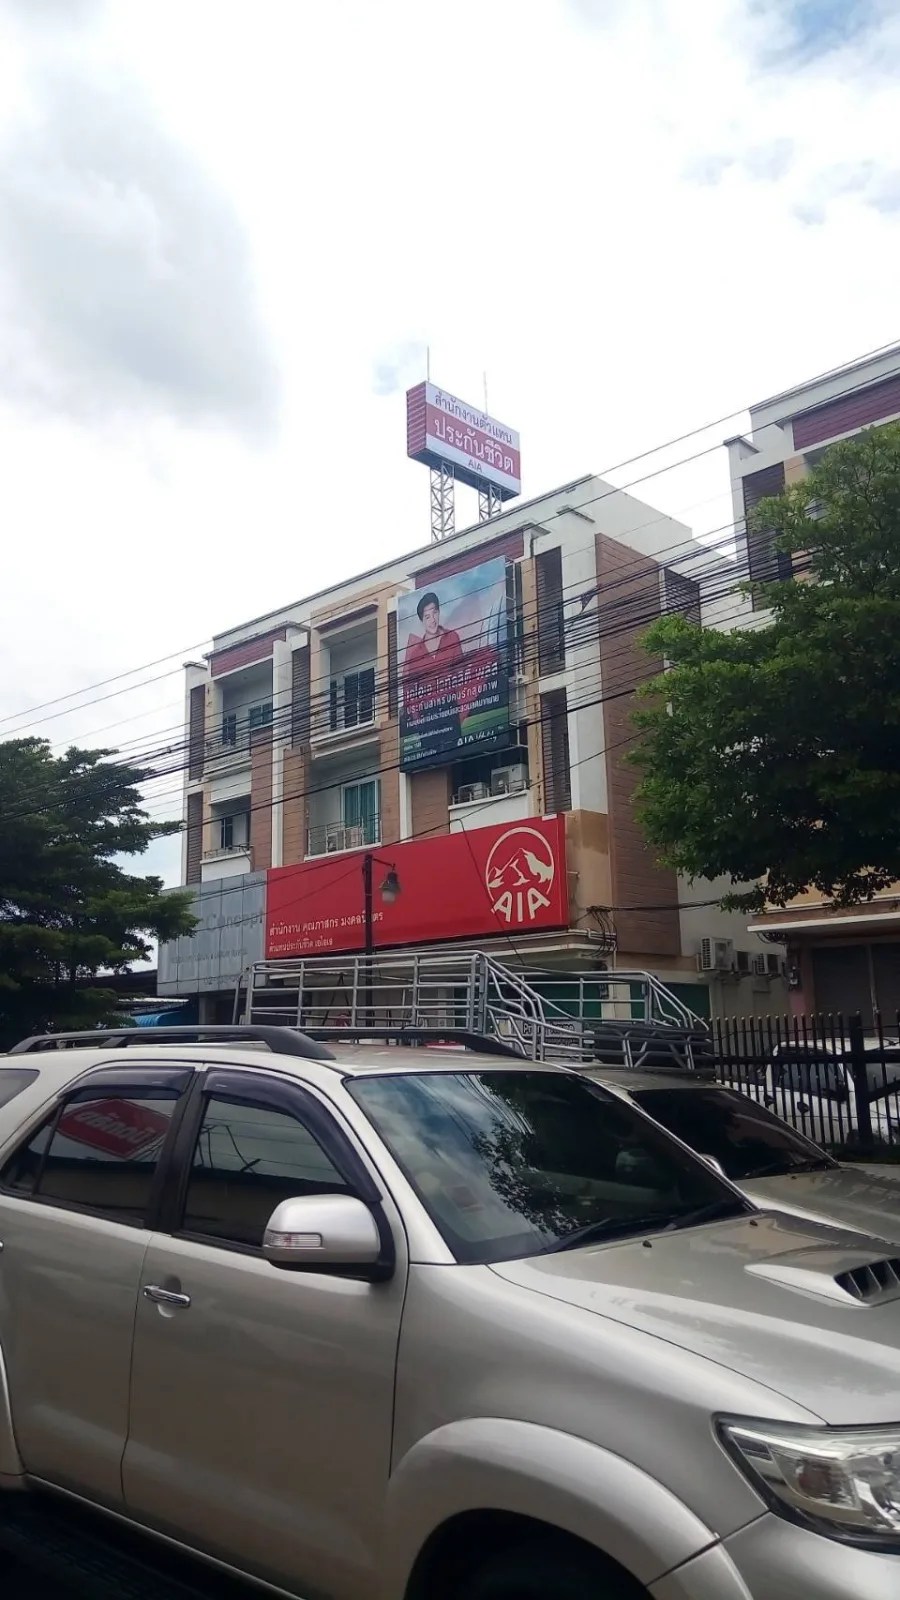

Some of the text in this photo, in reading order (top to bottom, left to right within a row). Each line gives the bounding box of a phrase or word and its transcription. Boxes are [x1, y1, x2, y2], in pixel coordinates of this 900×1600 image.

[435, 391, 513, 444] สำนักงานตัวแทน
[434, 416, 514, 474] ประกันชีวิต
[468, 459, 483, 473] AIA
[490, 887, 551, 922] AIA
[269, 921, 301, 937] สำนักงาน
